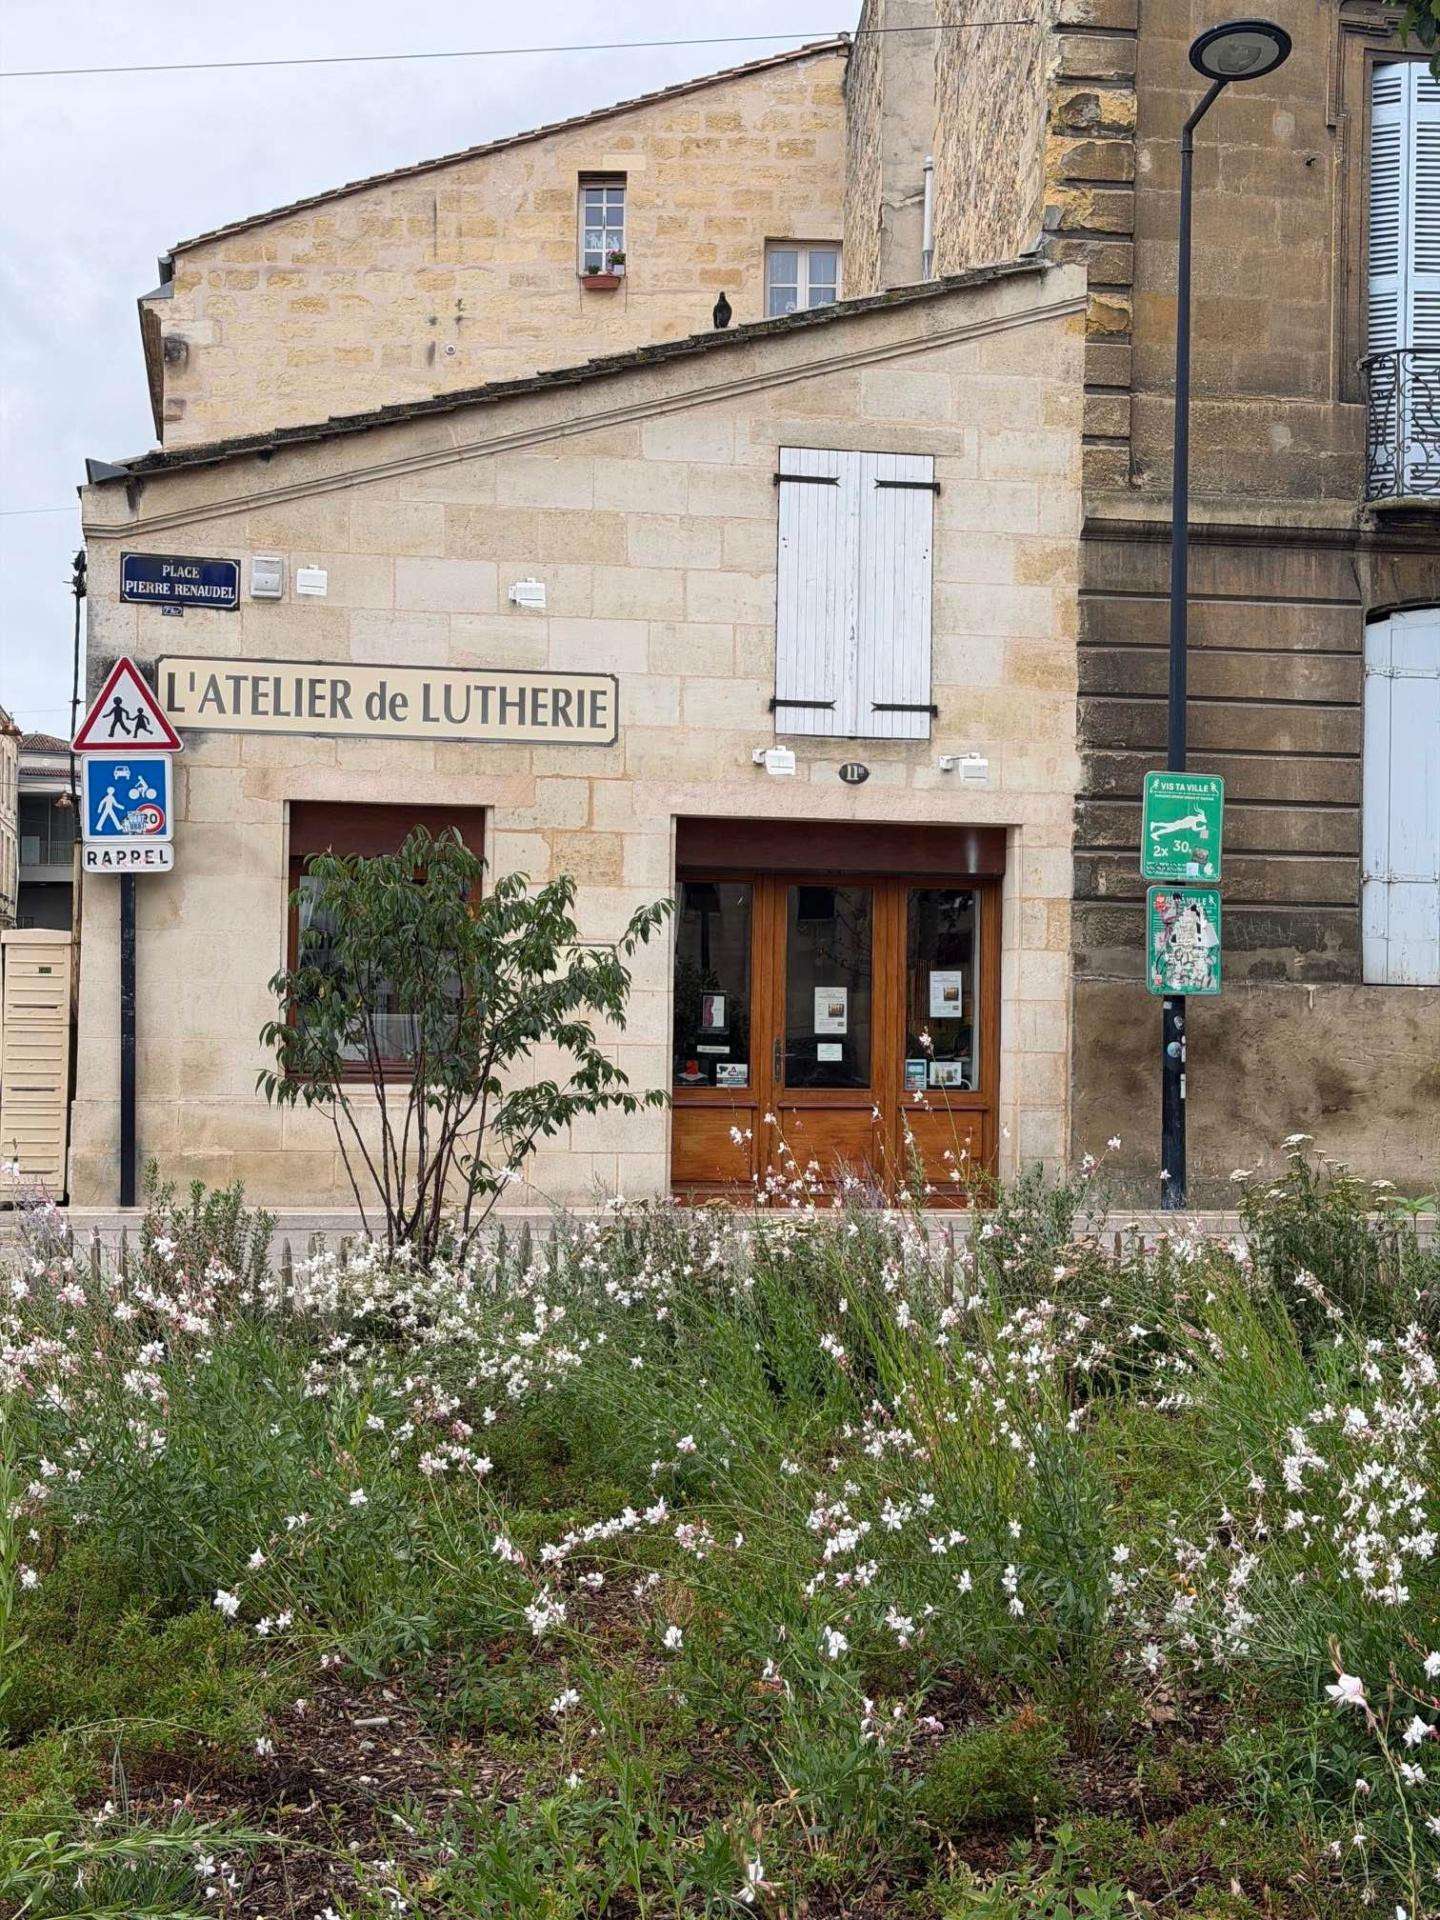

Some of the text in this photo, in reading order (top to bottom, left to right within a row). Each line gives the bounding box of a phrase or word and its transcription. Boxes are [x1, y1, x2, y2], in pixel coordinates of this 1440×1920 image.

[162, 564, 200, 578] PLACE
[125, 580, 235, 599] PIERRE RENAUDEL
[167, 671, 607, 729] L'ATELIER de LUTHERIE
[1186, 783, 1209, 792] VILLE
[86, 849, 169, 866] RAPPEL
